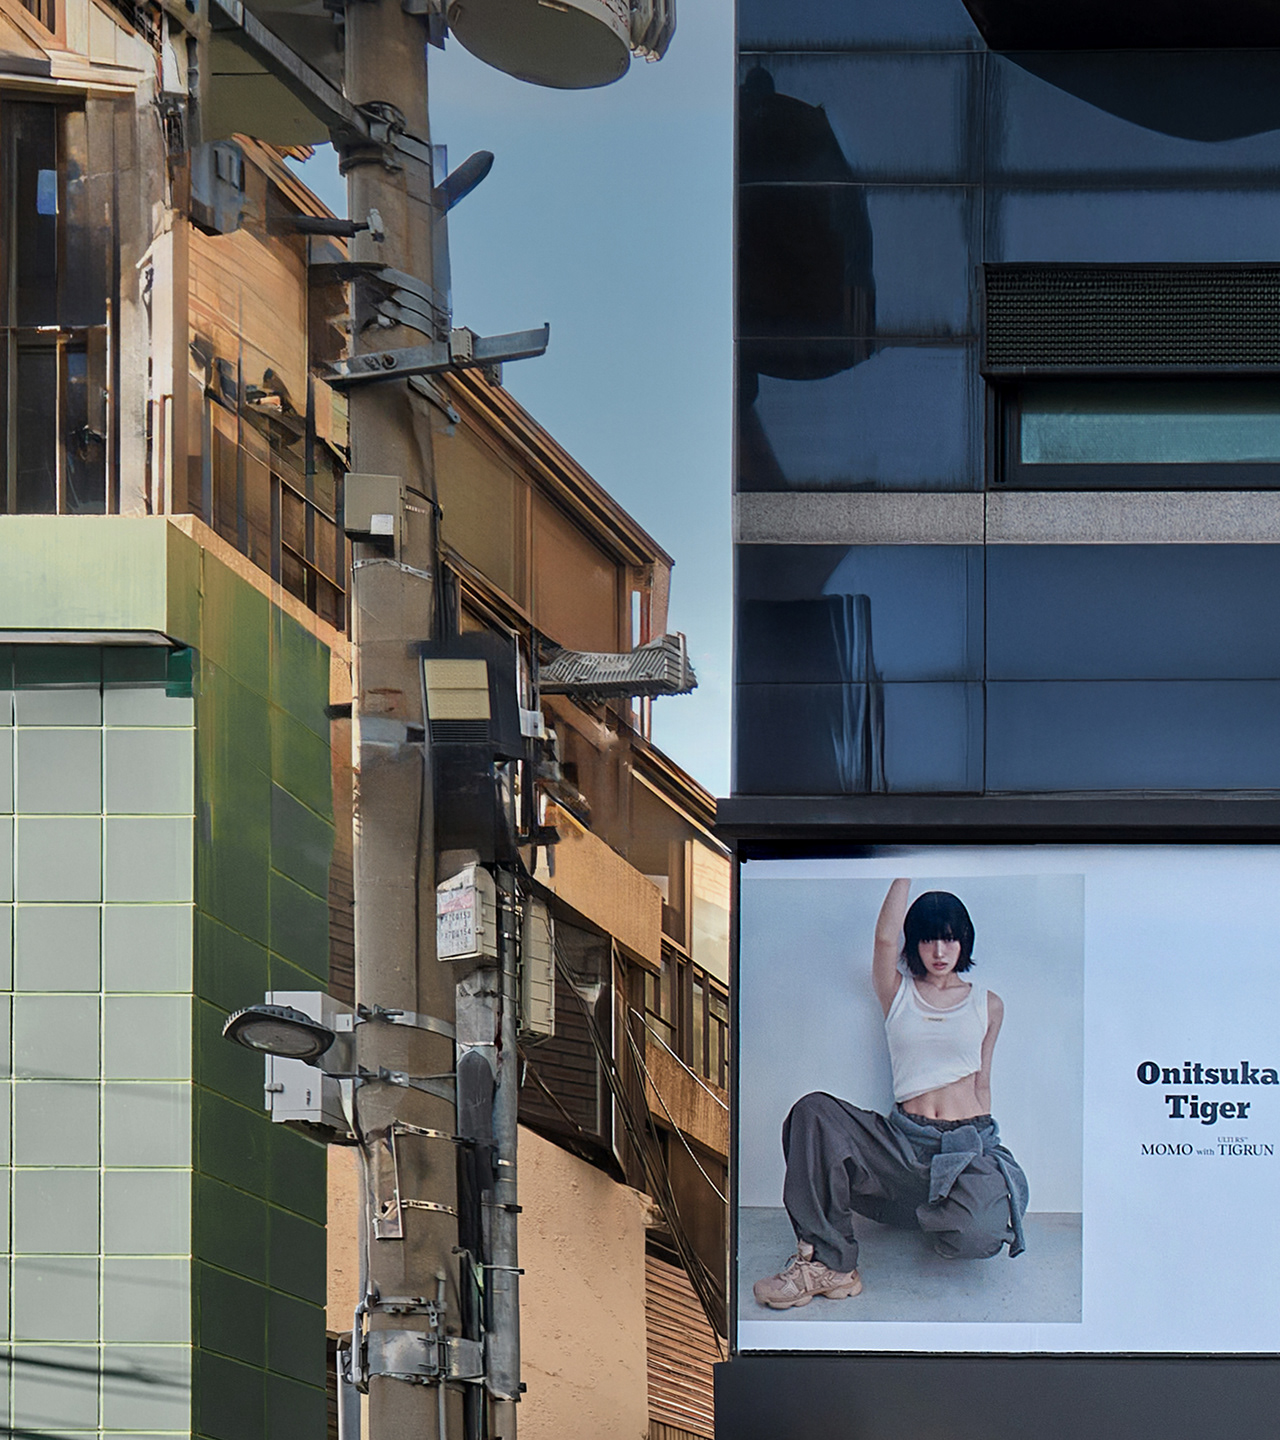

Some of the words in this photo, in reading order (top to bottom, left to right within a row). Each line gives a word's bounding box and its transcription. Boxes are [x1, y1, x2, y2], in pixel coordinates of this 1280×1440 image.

[1136, 1061, 1280, 1085] Onitsuka
[1164, 1094, 1251, 1126] Tiger
[1141, 1143, 1194, 1156] MOMO
[1196, 1148, 1215, 1156] with
[1217, 1143, 1274, 1156] TIGRUN
